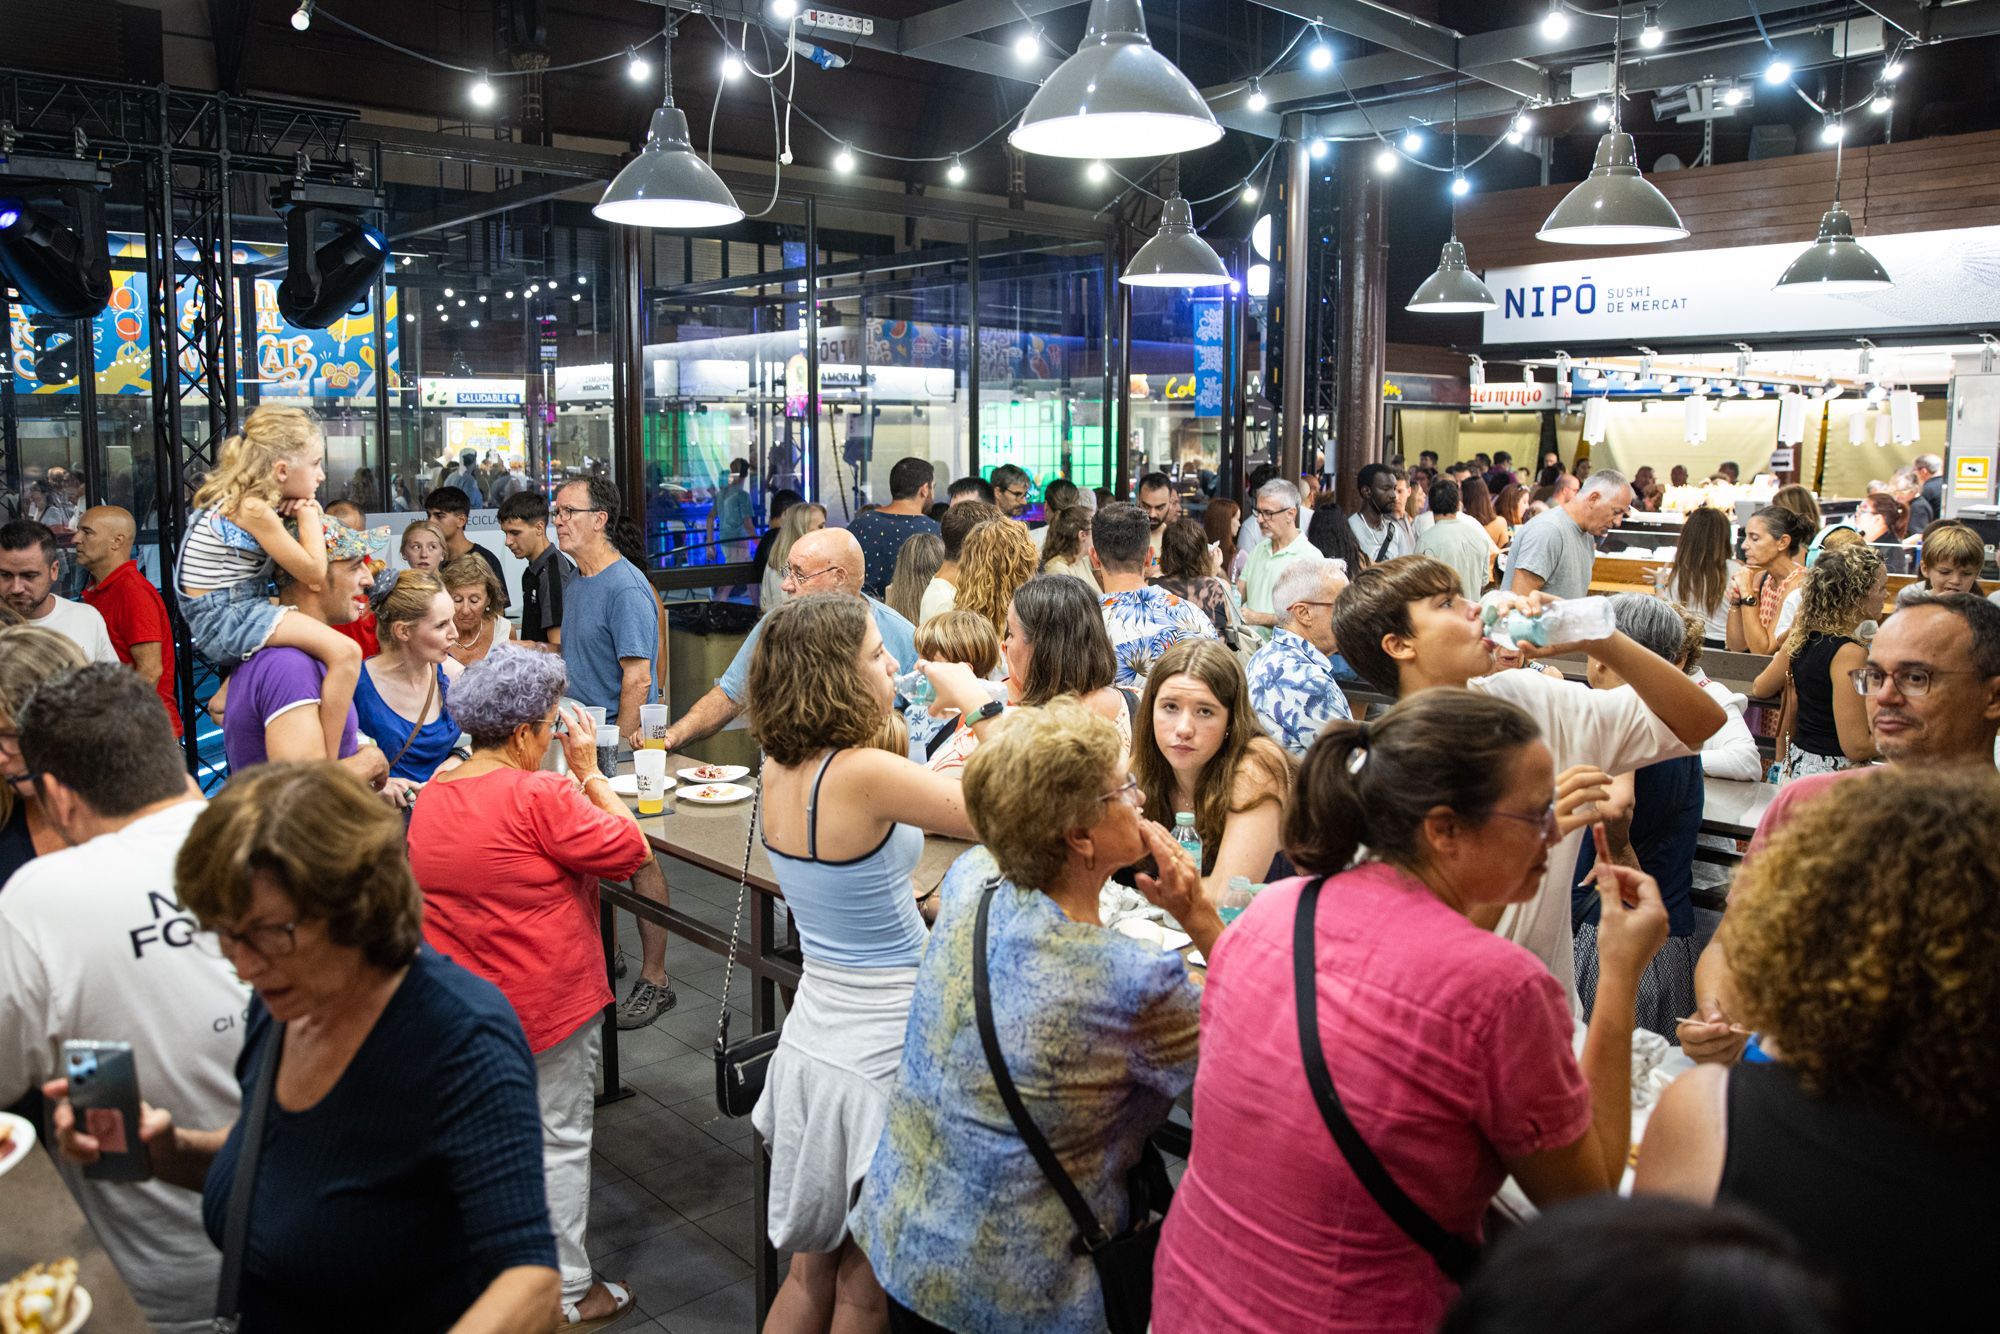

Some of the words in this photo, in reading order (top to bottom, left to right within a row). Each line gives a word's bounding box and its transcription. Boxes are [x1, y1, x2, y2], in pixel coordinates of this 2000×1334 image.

[1505, 276, 1596, 319] NIPŌ
[1607, 286, 1651, 299] SUSHI
[1607, 302, 1625, 313] DE
[1631, 298, 1688, 312] MERCAT
[1165, 376, 1197, 399] Col
[458, 392, 508, 403] SALUDABLE
[467, 515, 498, 526] ECICLA
